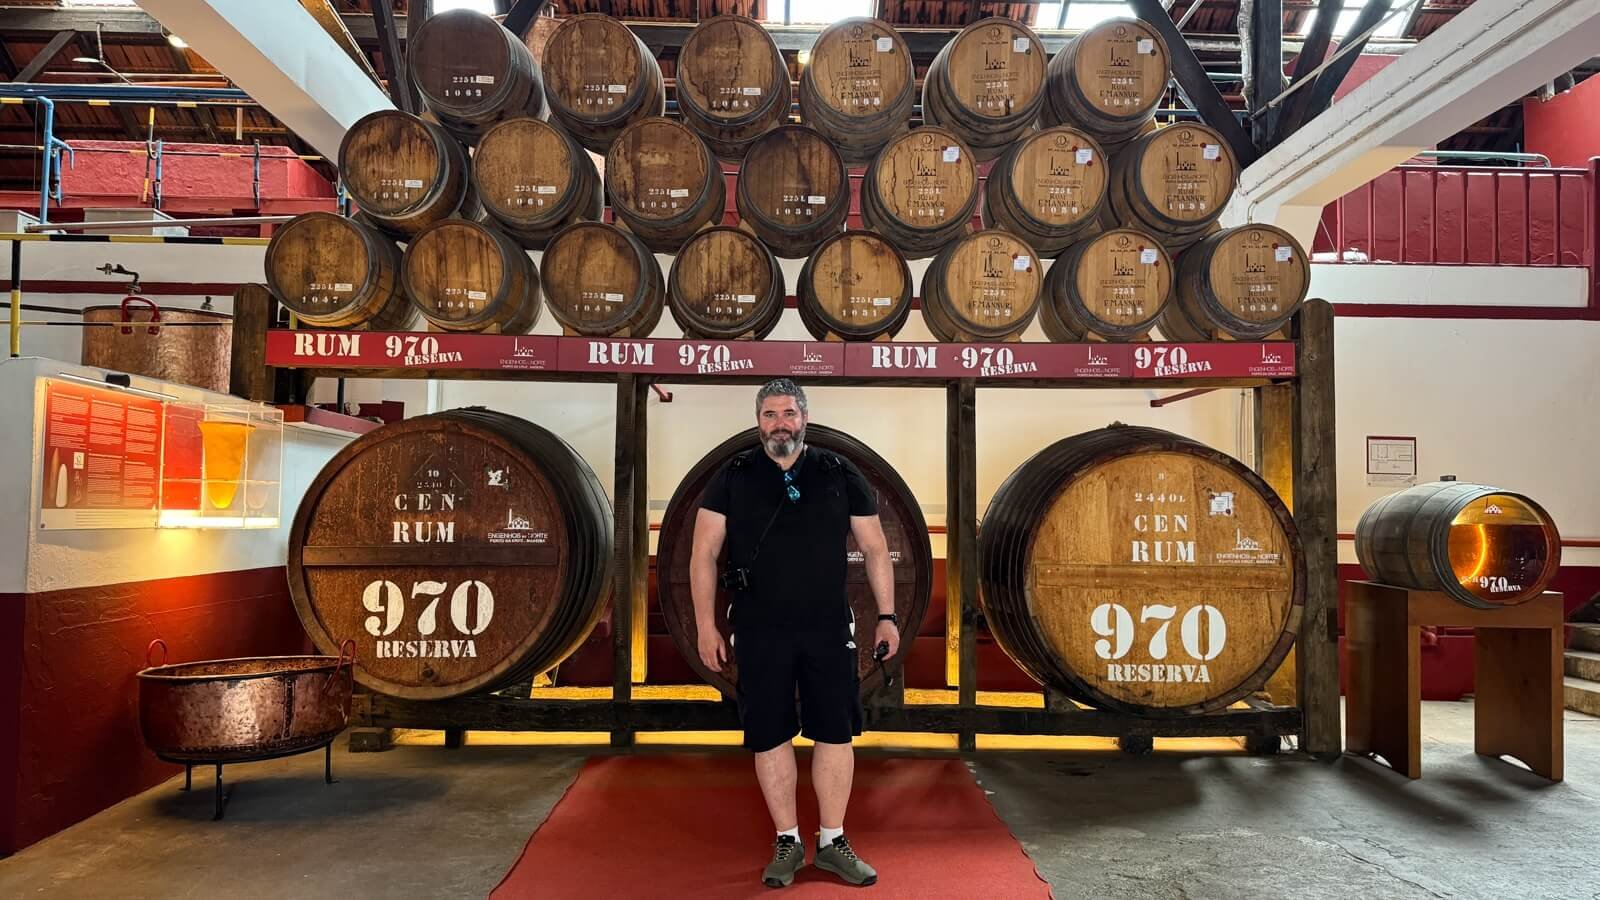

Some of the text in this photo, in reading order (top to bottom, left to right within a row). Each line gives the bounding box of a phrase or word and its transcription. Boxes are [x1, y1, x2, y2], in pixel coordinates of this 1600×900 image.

[294, 333, 439, 358] RUM 970
[588, 341, 731, 366] RUM 970
[404, 351, 463, 366] RESERVA
[697, 358, 754, 374] RESERVA
[871, 345, 1014, 369] RUM 970
[1134, 346, 1188, 369] 970
[980, 361, 1038, 377] RESERVA
[1154, 360, 1213, 377] RESERVA
[428, 469, 440, 478] 10
[394, 493, 455, 511] CEN
[392, 521, 455, 543] RUM
[1134, 515, 1188, 532] CEN
[1131, 541, 1196, 563] RUM
[1479, 575, 1508, 590] 970
[362, 580, 495, 637] 970
[1090, 603, 1227, 661] 970
[376, 639, 477, 659] RESERVA
[1107, 663, 1211, 683] RESERVA
